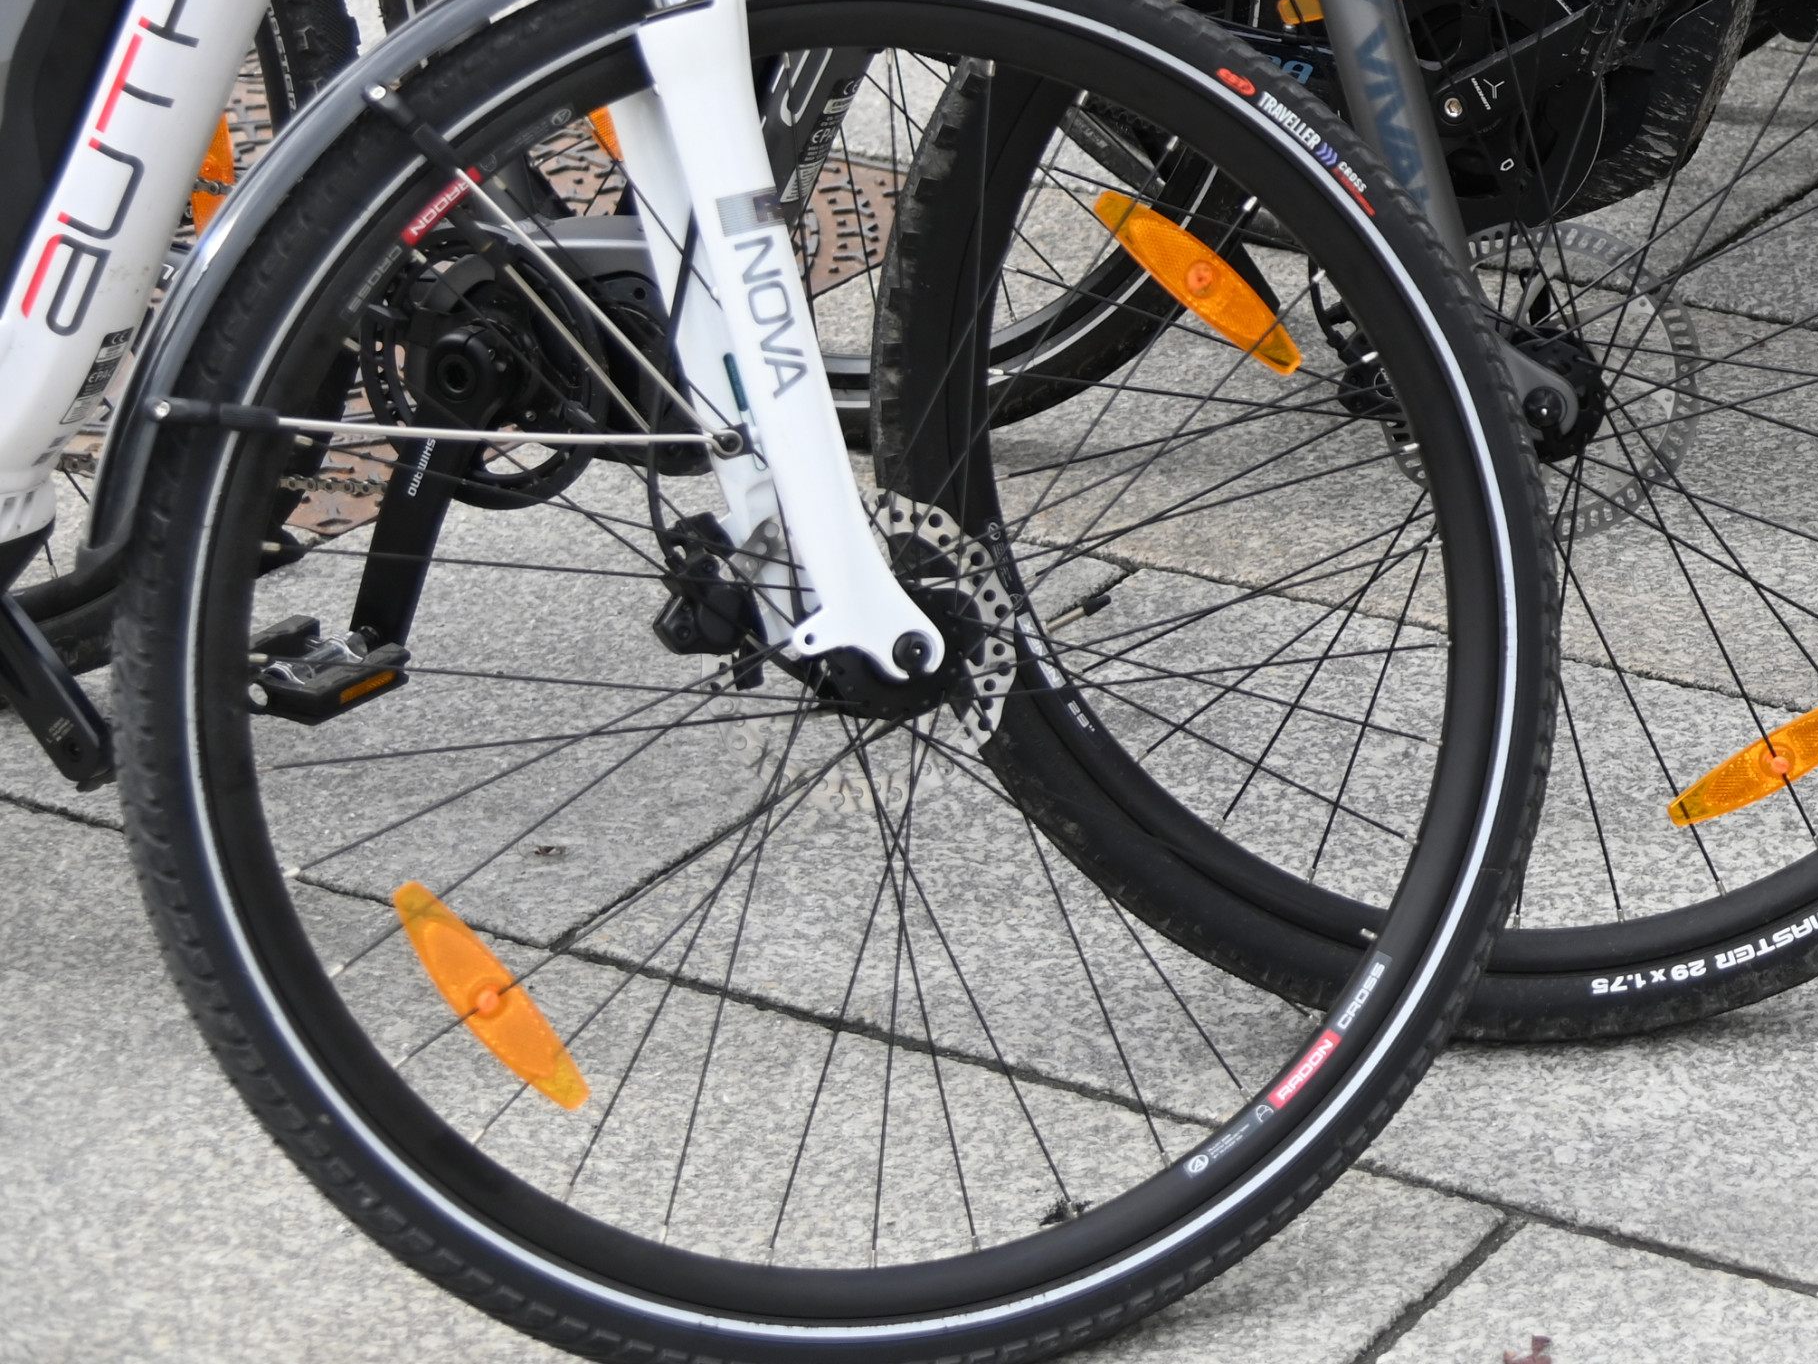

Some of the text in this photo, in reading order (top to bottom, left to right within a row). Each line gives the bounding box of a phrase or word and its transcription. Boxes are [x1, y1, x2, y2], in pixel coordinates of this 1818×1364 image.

[1257, 90, 1368, 193] TRAVELLER CROSS
[734, 234, 809, 400] NOVA
[407, 437, 437, 497] SHIMANO
[1590, 972, 1648, 996] 1.75
[1651, 967, 1668, 983] x
[1669, 958, 1708, 982] 29
[1275, 962, 1386, 1101] RADON CROSS
